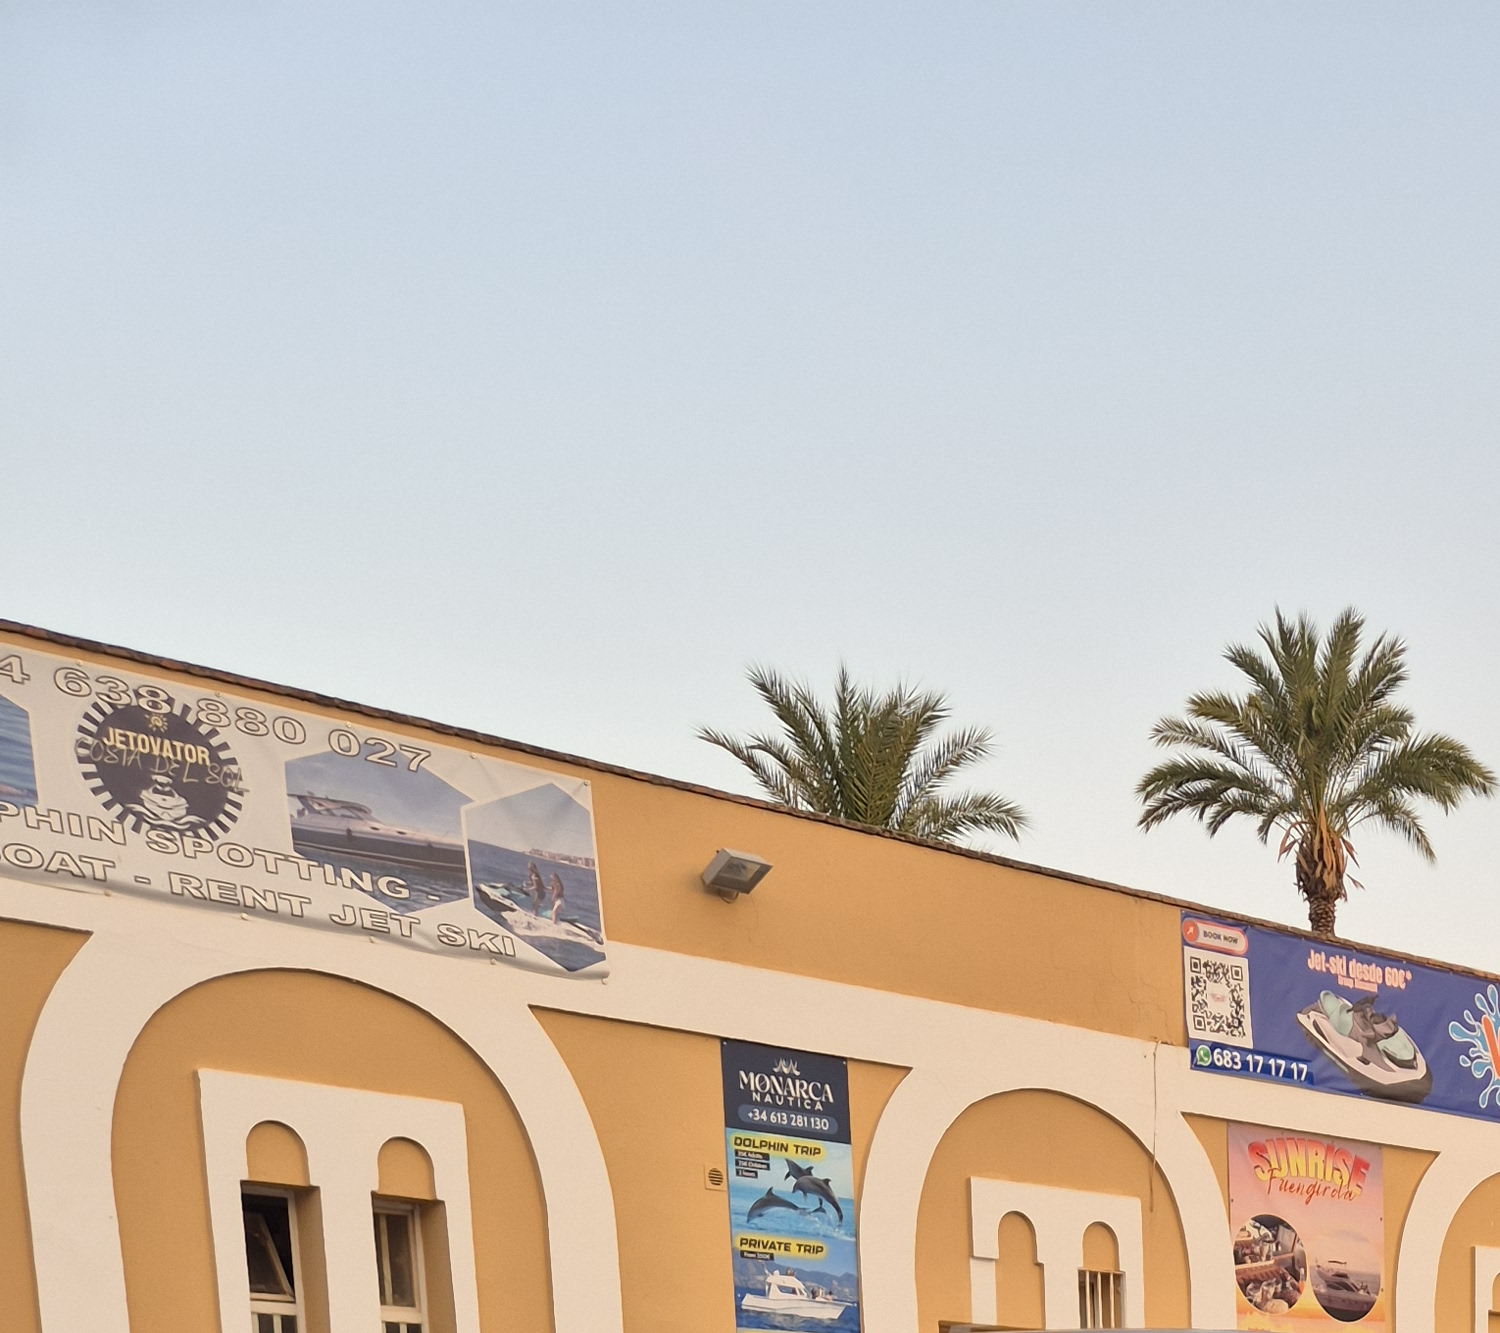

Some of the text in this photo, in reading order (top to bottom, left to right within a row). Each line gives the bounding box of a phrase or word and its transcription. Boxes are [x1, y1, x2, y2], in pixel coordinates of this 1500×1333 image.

[53, 666, 172, 715] 638
[196, 697, 307, 746] 880
[328, 727, 431, 772] 027
[103, 726, 210, 766] JETOVATOR
[74, 737, 250, 794] COSTA DEL SOL
[145, 828, 411, 901] SPOTTING
[0, 843, 116, 883] OAT
[168, 872, 311, 918] RENT
[329, 904, 421, 938] JET
[437, 923, 516, 957] SKI
[1203, 930, 1239, 945] BOOK NOW
[1307, 949, 1347, 975] Jet-ski
[1349, 957, 1383, 984] desde
[1213, 1047, 1308, 1082] 683 17 17 17
[739, 1070, 834, 1103] MONARCA
[752, 1091, 823, 1111] NAUTICA
[748, 1108, 829, 1131] +34 613 281 130
[734, 1136, 822, 1156] DOLPHIN TRIP
[1247, 1137, 1370, 1196] SUNRISE
[1267, 1168, 1356, 1205] Fuengirola
[740, 1237, 824, 1255] PRIVATE TRIP
